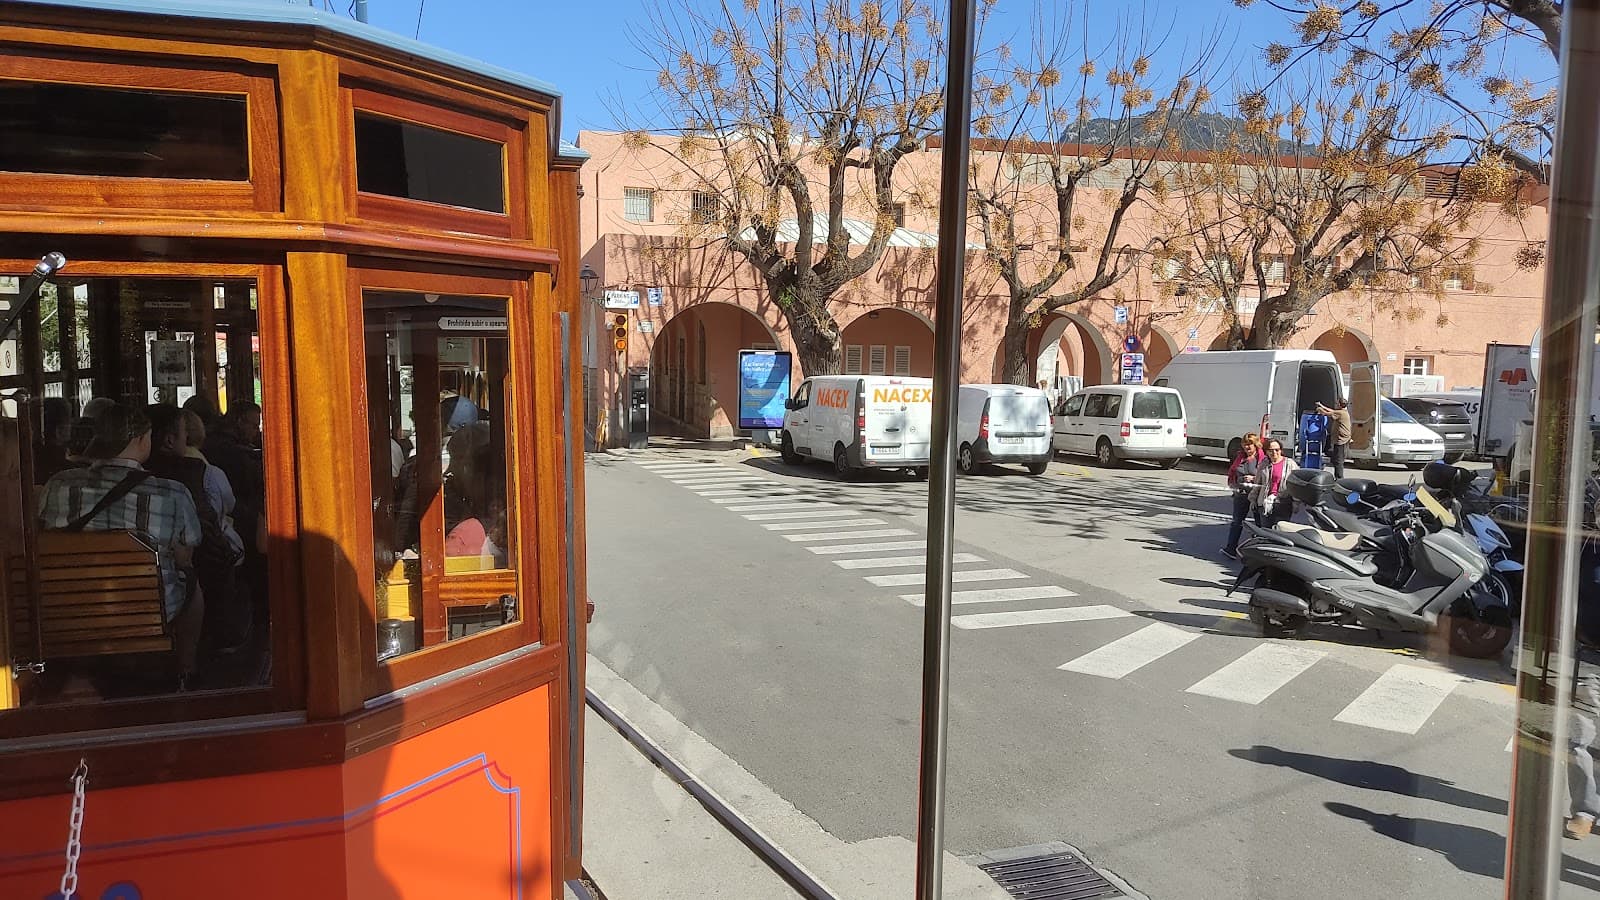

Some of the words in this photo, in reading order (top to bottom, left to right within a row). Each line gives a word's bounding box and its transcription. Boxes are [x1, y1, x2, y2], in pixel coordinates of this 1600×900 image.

[817, 387, 849, 408] NACEX
[874, 388, 931, 402] NACEX
[1337, 599, 1356, 609] SYM
